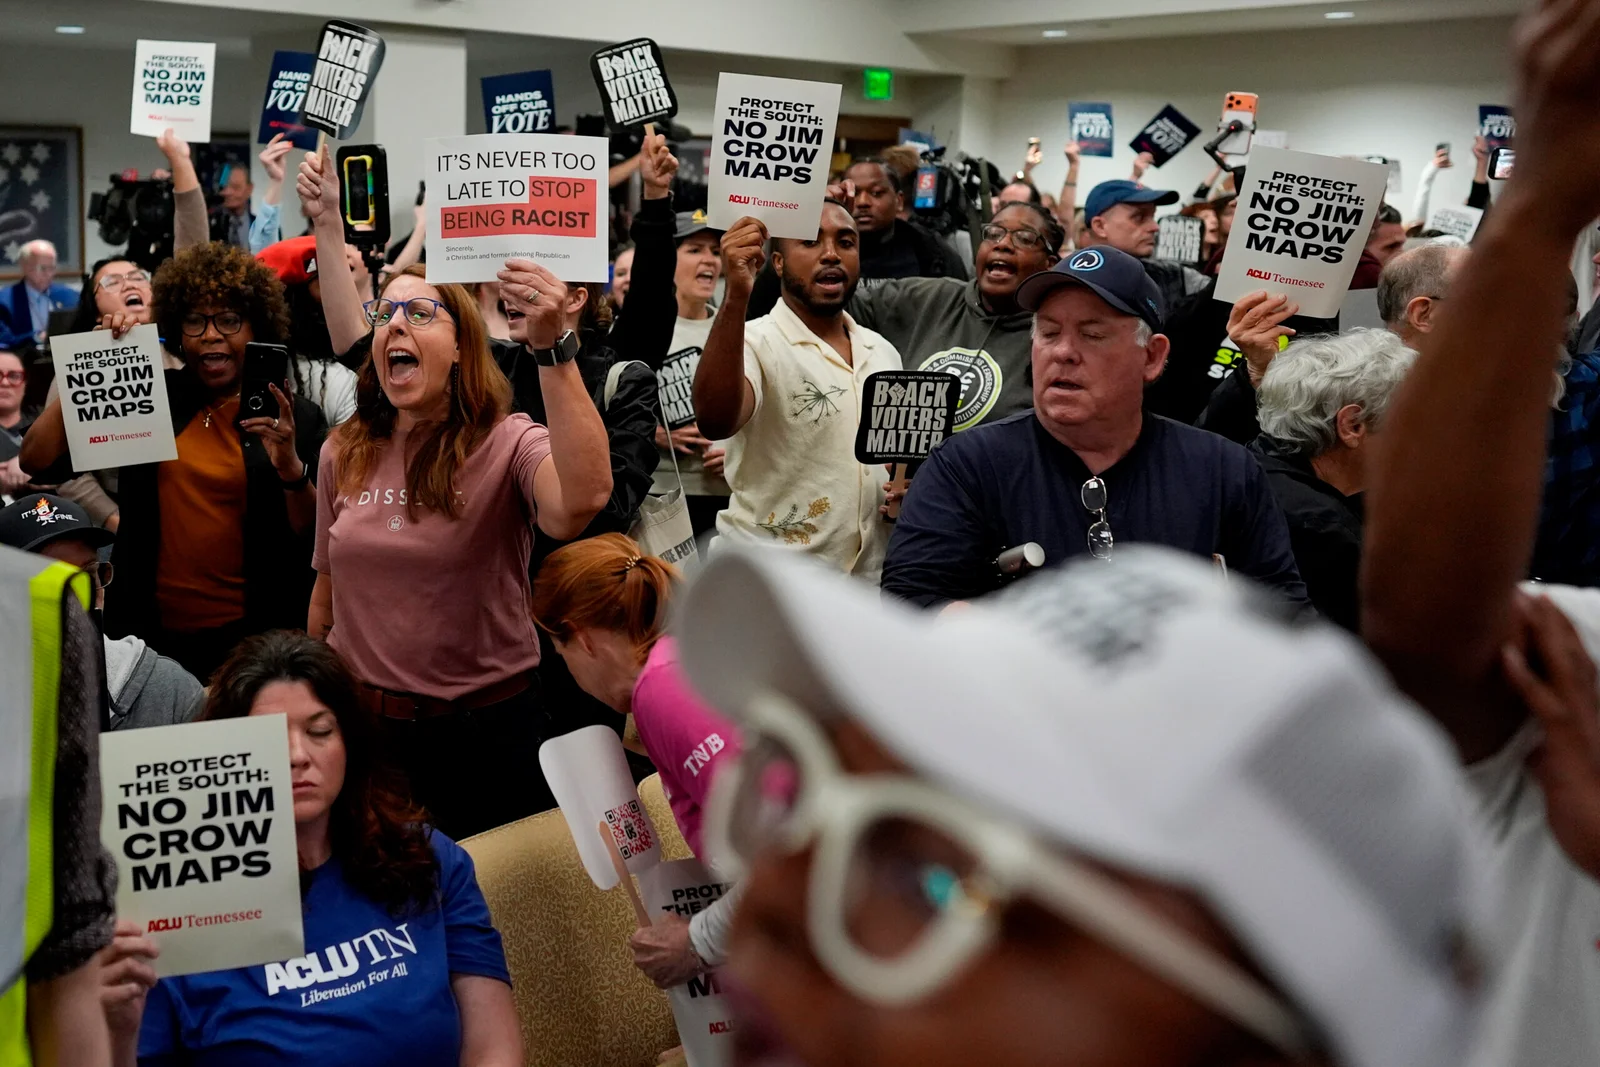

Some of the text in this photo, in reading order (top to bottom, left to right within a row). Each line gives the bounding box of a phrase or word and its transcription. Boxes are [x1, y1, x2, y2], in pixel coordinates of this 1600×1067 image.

[142, 69, 206, 81] NO JIM
[272, 79, 294, 90] OFF
[278, 71, 311, 81] HAND
[604, 67, 665, 102] VOTERS
[143, 81, 203, 93] CROW
[495, 90, 542, 104] HANDS
[145, 94, 201, 106] MAPS
[266, 89, 306, 112] VOT
[304, 85, 357, 127] MATTER
[491, 100, 548, 114] OFF OUR
[610, 87, 672, 124] MATTER
[740, 97, 815, 113] PROTECT
[491, 108, 552, 134] VOTE
[728, 107, 823, 126] THE SOUTH:
[723, 119, 824, 146] NO JIM
[476, 151, 546, 169] NEVER
[551, 152, 596, 171] TOO
[723, 139, 819, 165] CROW
[724, 159, 812, 184] MAPS
[1272, 171, 1358, 193] PROTECT
[447, 180, 585, 201] LATE TO STOP
[728, 194, 799, 210] ACLU Tennessee
[1258, 179, 1365, 206] THE SOUTH:
[444, 209, 590, 230] BEING RACIST
[1249, 191, 1364, 226] NO JIM
[1247, 213, 1356, 245] CROW
[445, 245, 475, 253] Sincerely,
[450, 253, 478, 261] Christian
[511, 251, 534, 259] lifelong
[535, 251, 570, 259] Republican
[1245, 232, 1345, 264] MAPS
[1246, 268, 1325, 289] ACLU Tennessee
[65, 354, 150, 372] THE SOUTH:
[74, 345, 139, 361] PROTECT
[66, 364, 154, 389] NO JIM
[71, 382, 153, 405] CROW
[658, 378, 692, 405] VOTE
[77, 399, 155, 422] MAPS
[871, 406, 948, 431] VOTERS
[89, 431, 152, 444] ACLU Tennessee
[136, 752, 252, 779] PROTECT
[119, 768, 269, 797] THE SOUTH:
[118, 786, 274, 830] NO JIM
[123, 817, 272, 860] CROW
[132, 850, 271, 892] MAPS
[147, 908, 262, 933] ACLU Tennessee
[300, 962, 409, 1008] Liberation For All
